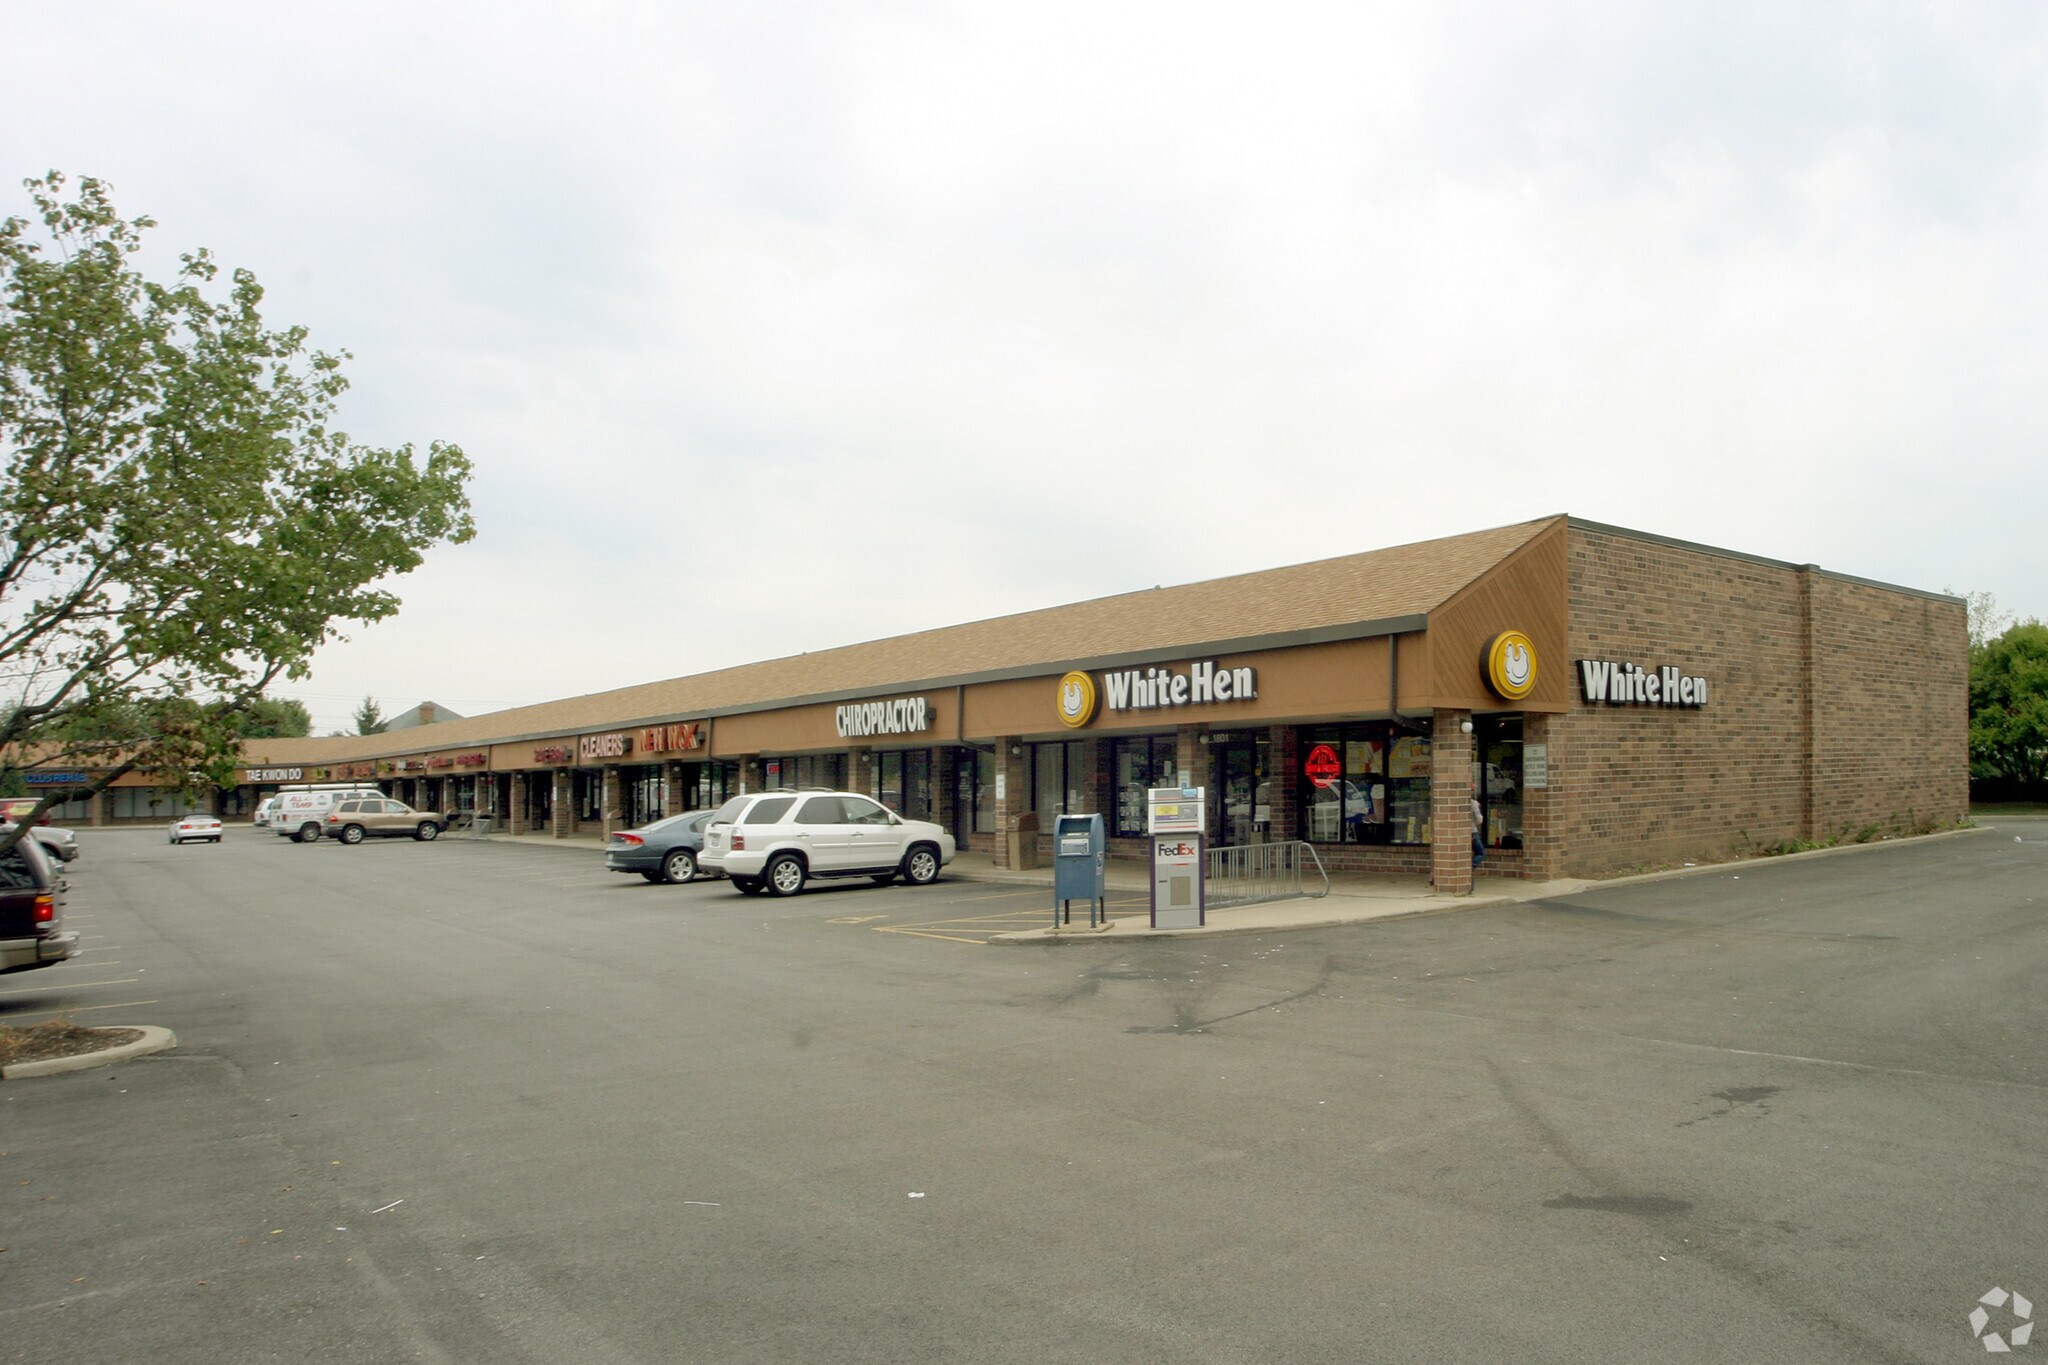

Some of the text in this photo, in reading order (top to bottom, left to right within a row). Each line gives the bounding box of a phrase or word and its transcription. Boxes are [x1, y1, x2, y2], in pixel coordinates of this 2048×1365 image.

[1105, 661, 1252, 710] White Hen
[1583, 660, 1708, 705] White Hen
[835, 697, 927, 738] CHIROPRACTOR
[580, 733, 624, 758] CLEANERS
[639, 723, 699, 753] NEW WOK
[245, 769, 262, 781] TAE
[262, 769, 288, 781] KWON
[288, 768, 303, 780] DO
[1158, 842, 1195, 857] FedEx
